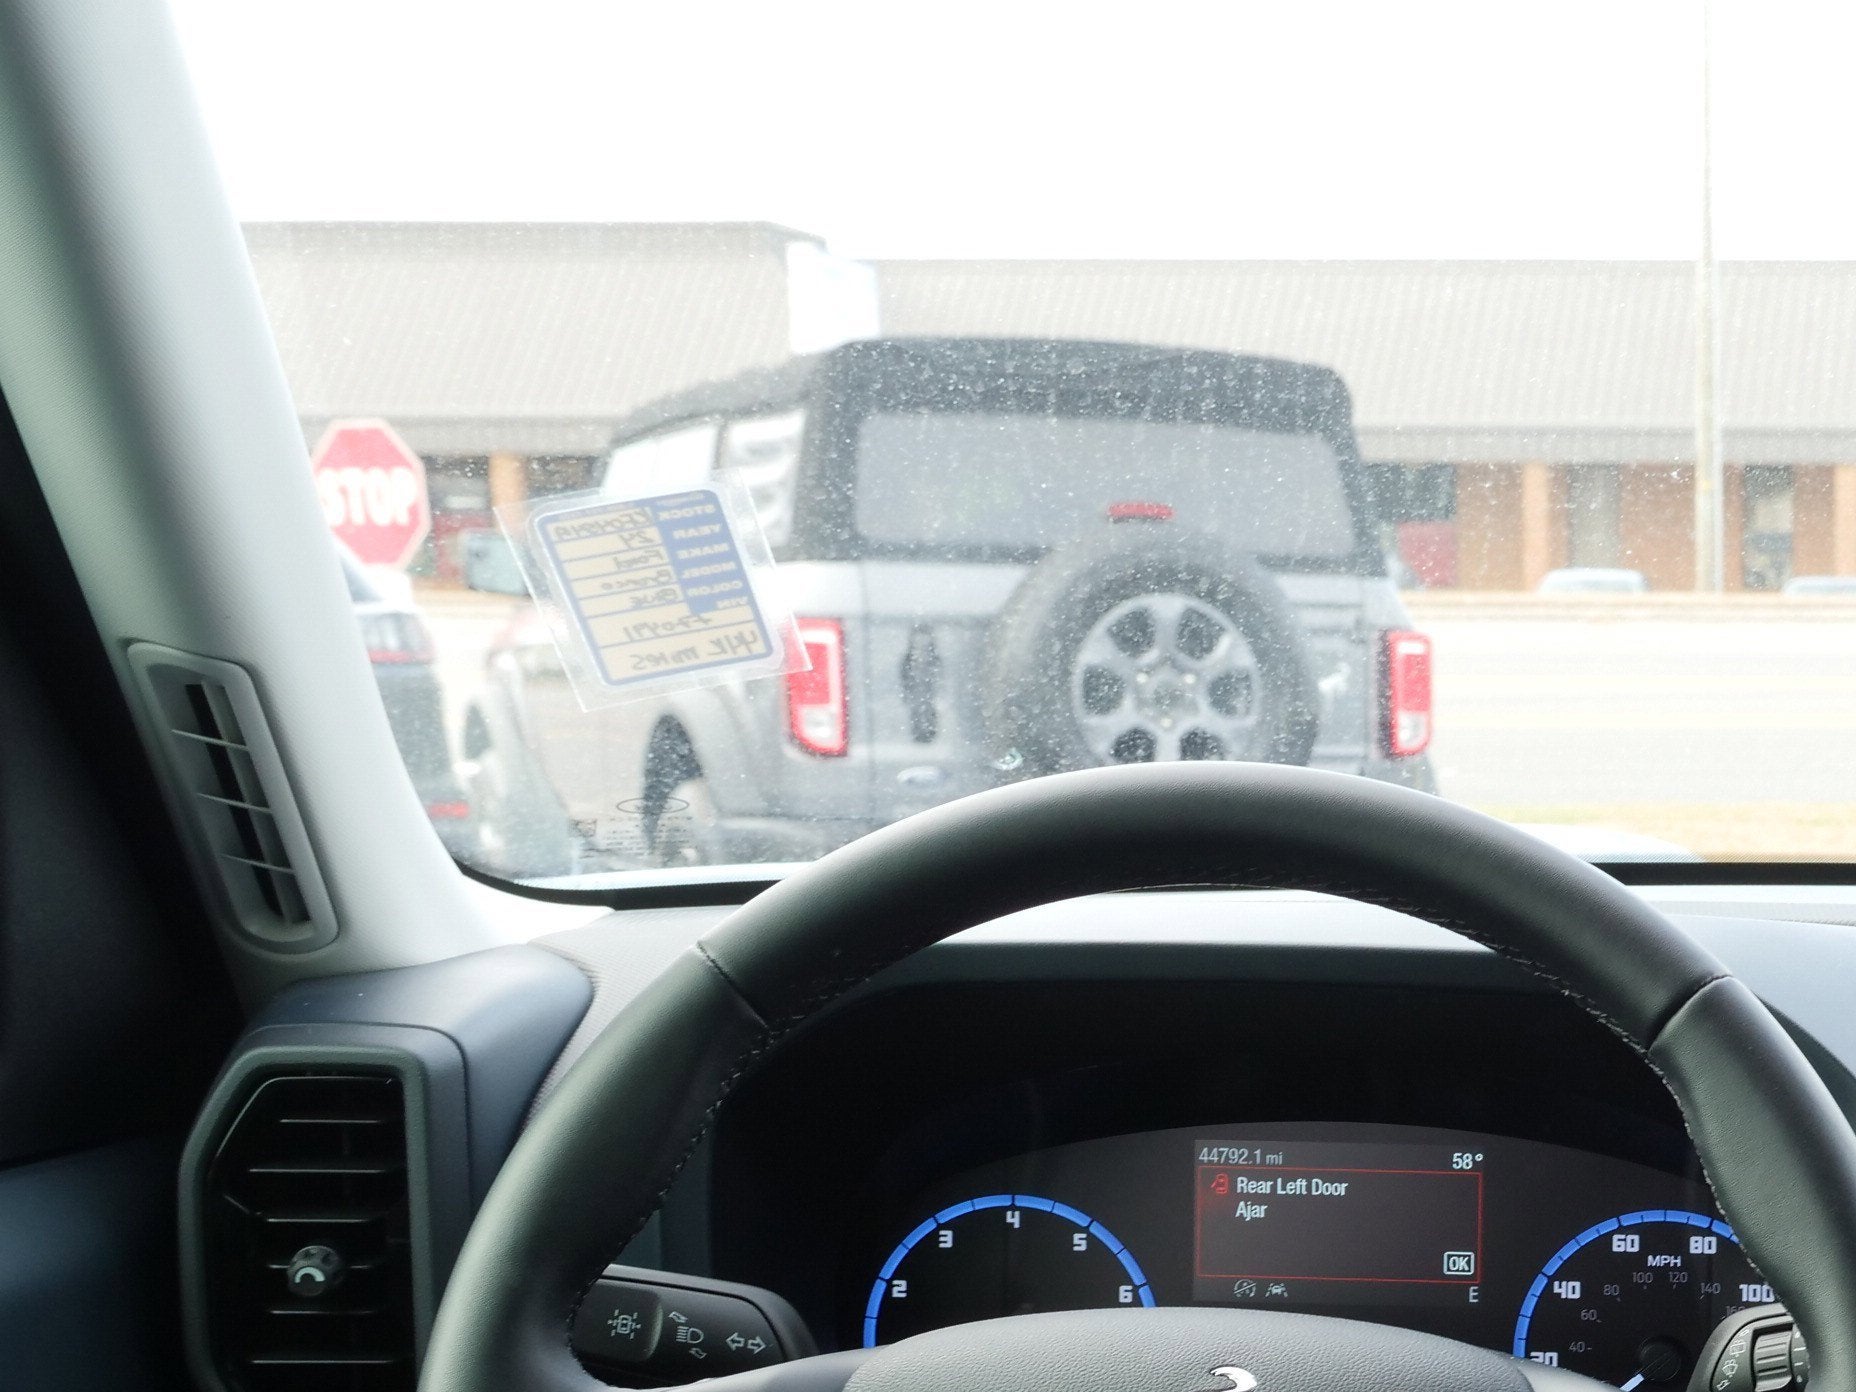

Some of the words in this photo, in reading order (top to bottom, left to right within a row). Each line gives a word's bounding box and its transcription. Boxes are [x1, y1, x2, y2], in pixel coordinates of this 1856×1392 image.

[318, 467, 417, 526] STOP
[1199, 1147, 1262, 1165] 44792.1
[1265, 1151, 1283, 1166] mi
[1452, 1152, 1484, 1170] 58°
[1236, 1176, 1273, 1194] Rear
[1277, 1177, 1308, 1195] Left
[1311, 1179, 1348, 1197] Door
[1006, 1211, 1020, 1228] 4
[1235, 1201, 1268, 1221] Ajar
[938, 1230, 953, 1248] 3
[1073, 1234, 1087, 1251] 5
[1612, 1234, 1640, 1252] 60
[1689, 1236, 1717, 1254] 80
[1448, 1256, 1470, 1271] OK
[1647, 1255, 1681, 1267] MPH
[1632, 1272, 1652, 1283] 100
[1669, 1272, 1688, 1283] 120
[892, 1280, 907, 1297] 2
[1118, 1286, 1133, 1303] 6
[1469, 1286, 1479, 1302] E
[1554, 1281, 1580, 1299] 40
[1604, 1284, 1620, 1296] 80
[1701, 1282, 1721, 1294] 140
[1739, 1284, 1774, 1302] 100
[1581, 1309, 1597, 1321] 60
[1569, 1341, 1585, 1352] 40
